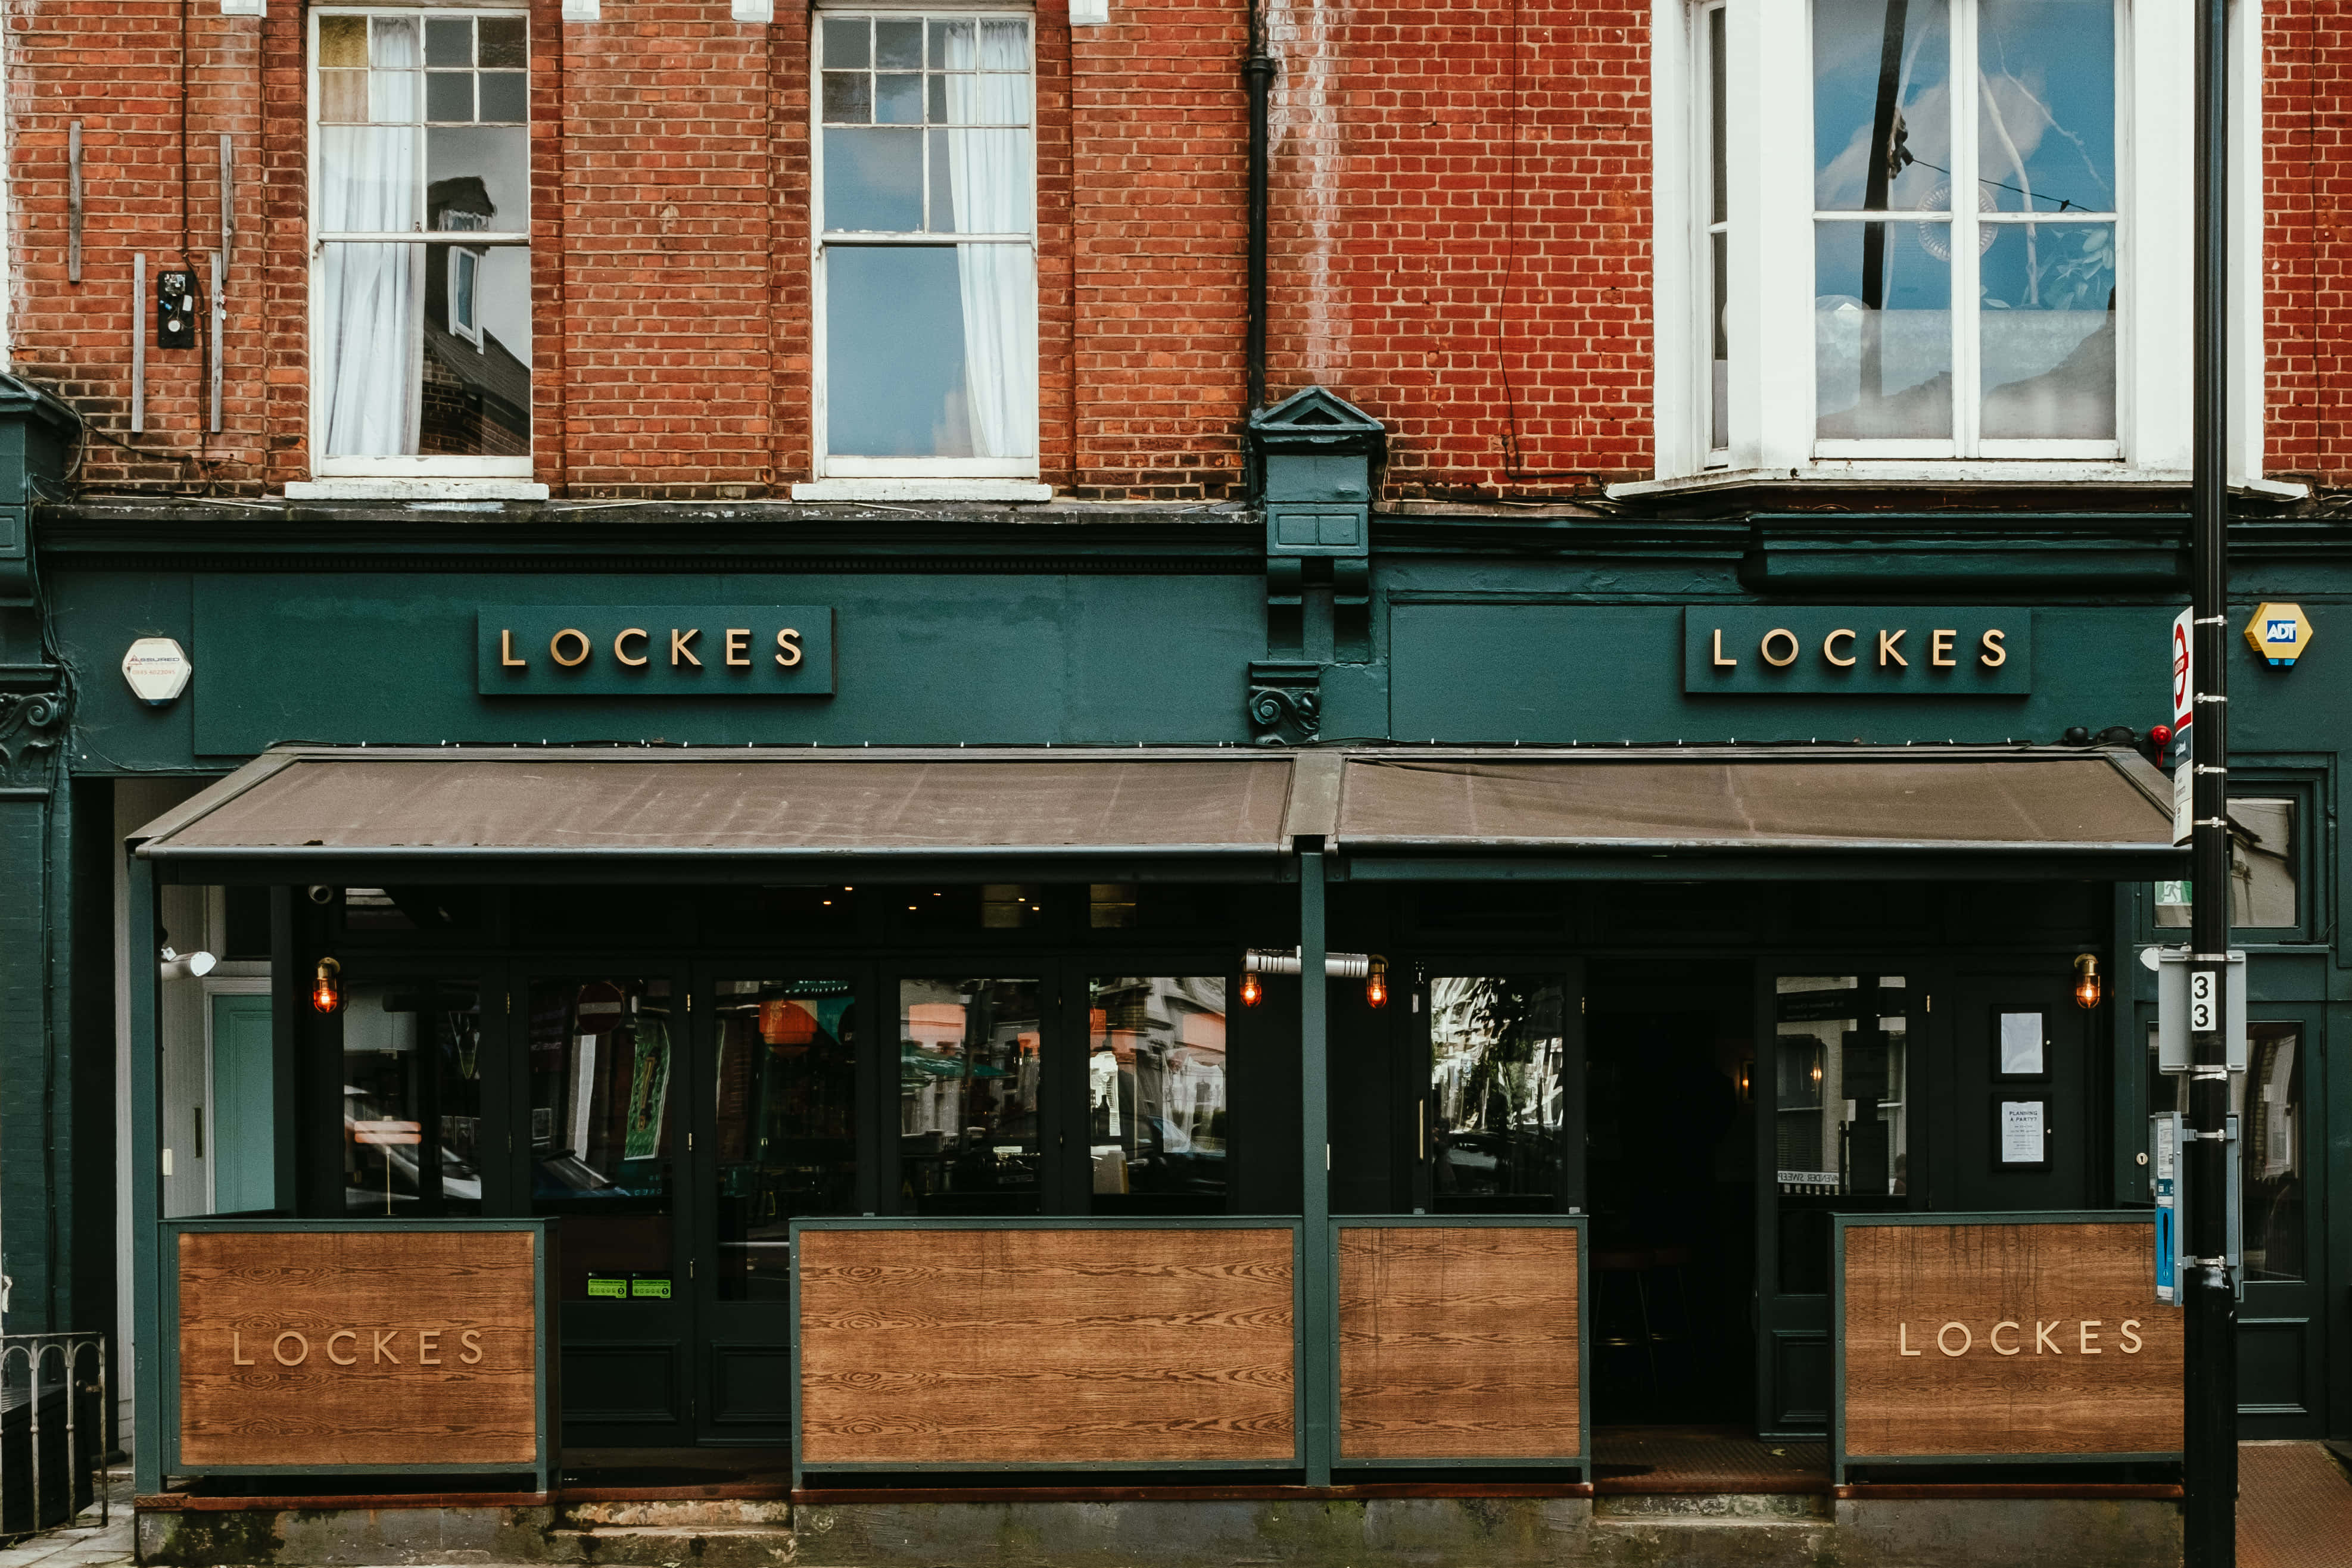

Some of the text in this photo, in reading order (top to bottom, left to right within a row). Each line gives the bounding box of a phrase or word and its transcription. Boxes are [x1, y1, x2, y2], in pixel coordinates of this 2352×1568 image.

[501, 628, 802, 666] LOCKES
[1713, 628, 2007, 666] LOCKES
[2267, 623, 2297, 640] ADT
[233, 1329, 483, 1367] LOCKES
[1899, 1319, 2142, 1357] LOCKES
